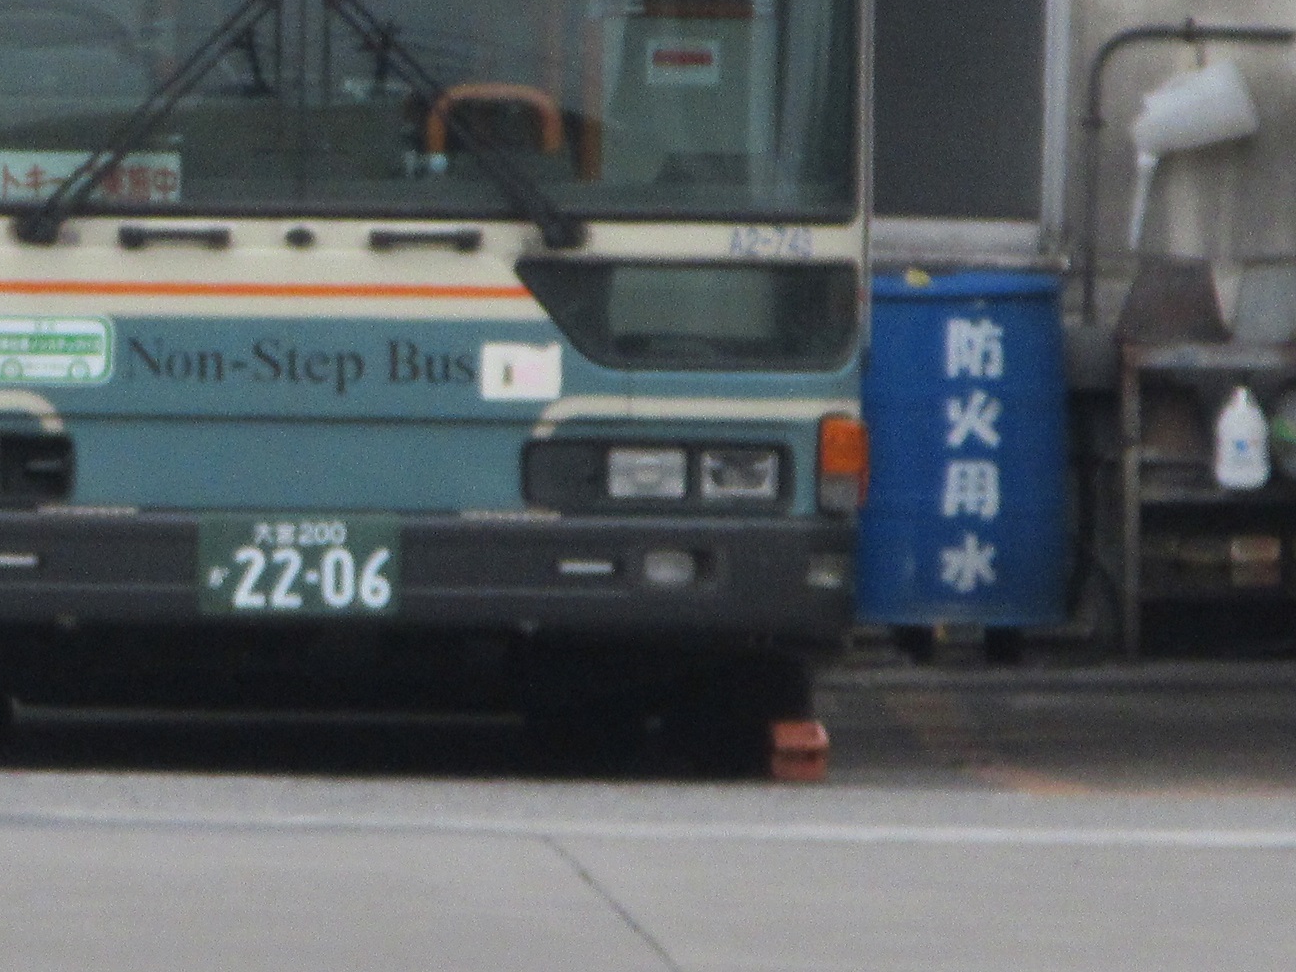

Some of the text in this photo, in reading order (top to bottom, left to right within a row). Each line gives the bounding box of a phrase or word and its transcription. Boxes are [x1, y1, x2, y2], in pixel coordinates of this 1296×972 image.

[128, 336, 477, 394] Non-Step Bus
[943, 318, 1004, 594] 防火用水
